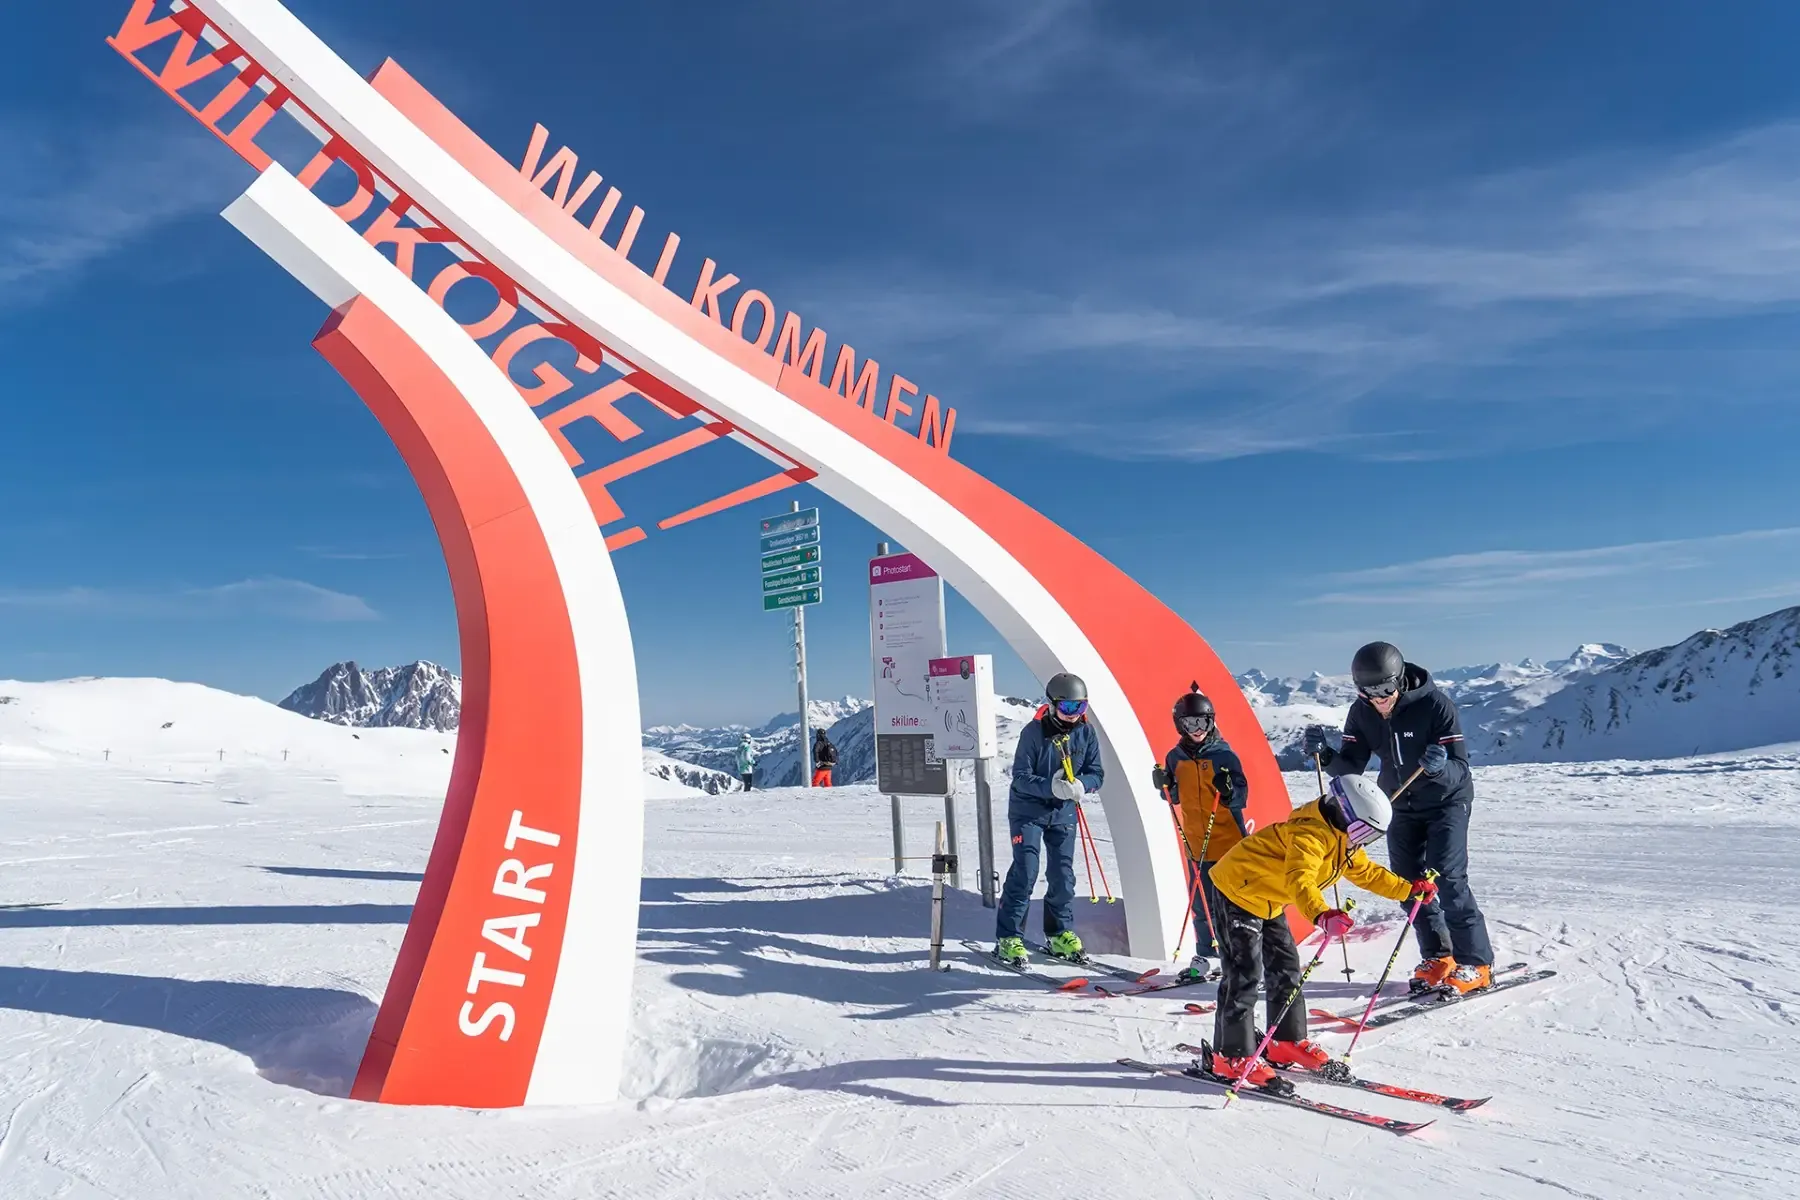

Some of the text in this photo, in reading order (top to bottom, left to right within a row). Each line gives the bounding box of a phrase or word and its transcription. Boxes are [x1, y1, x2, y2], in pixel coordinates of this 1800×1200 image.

[519, 122, 957, 457] WILLKOMMEN
[883, 564, 912, 575] Photostart
[458, 809, 561, 1042] START
